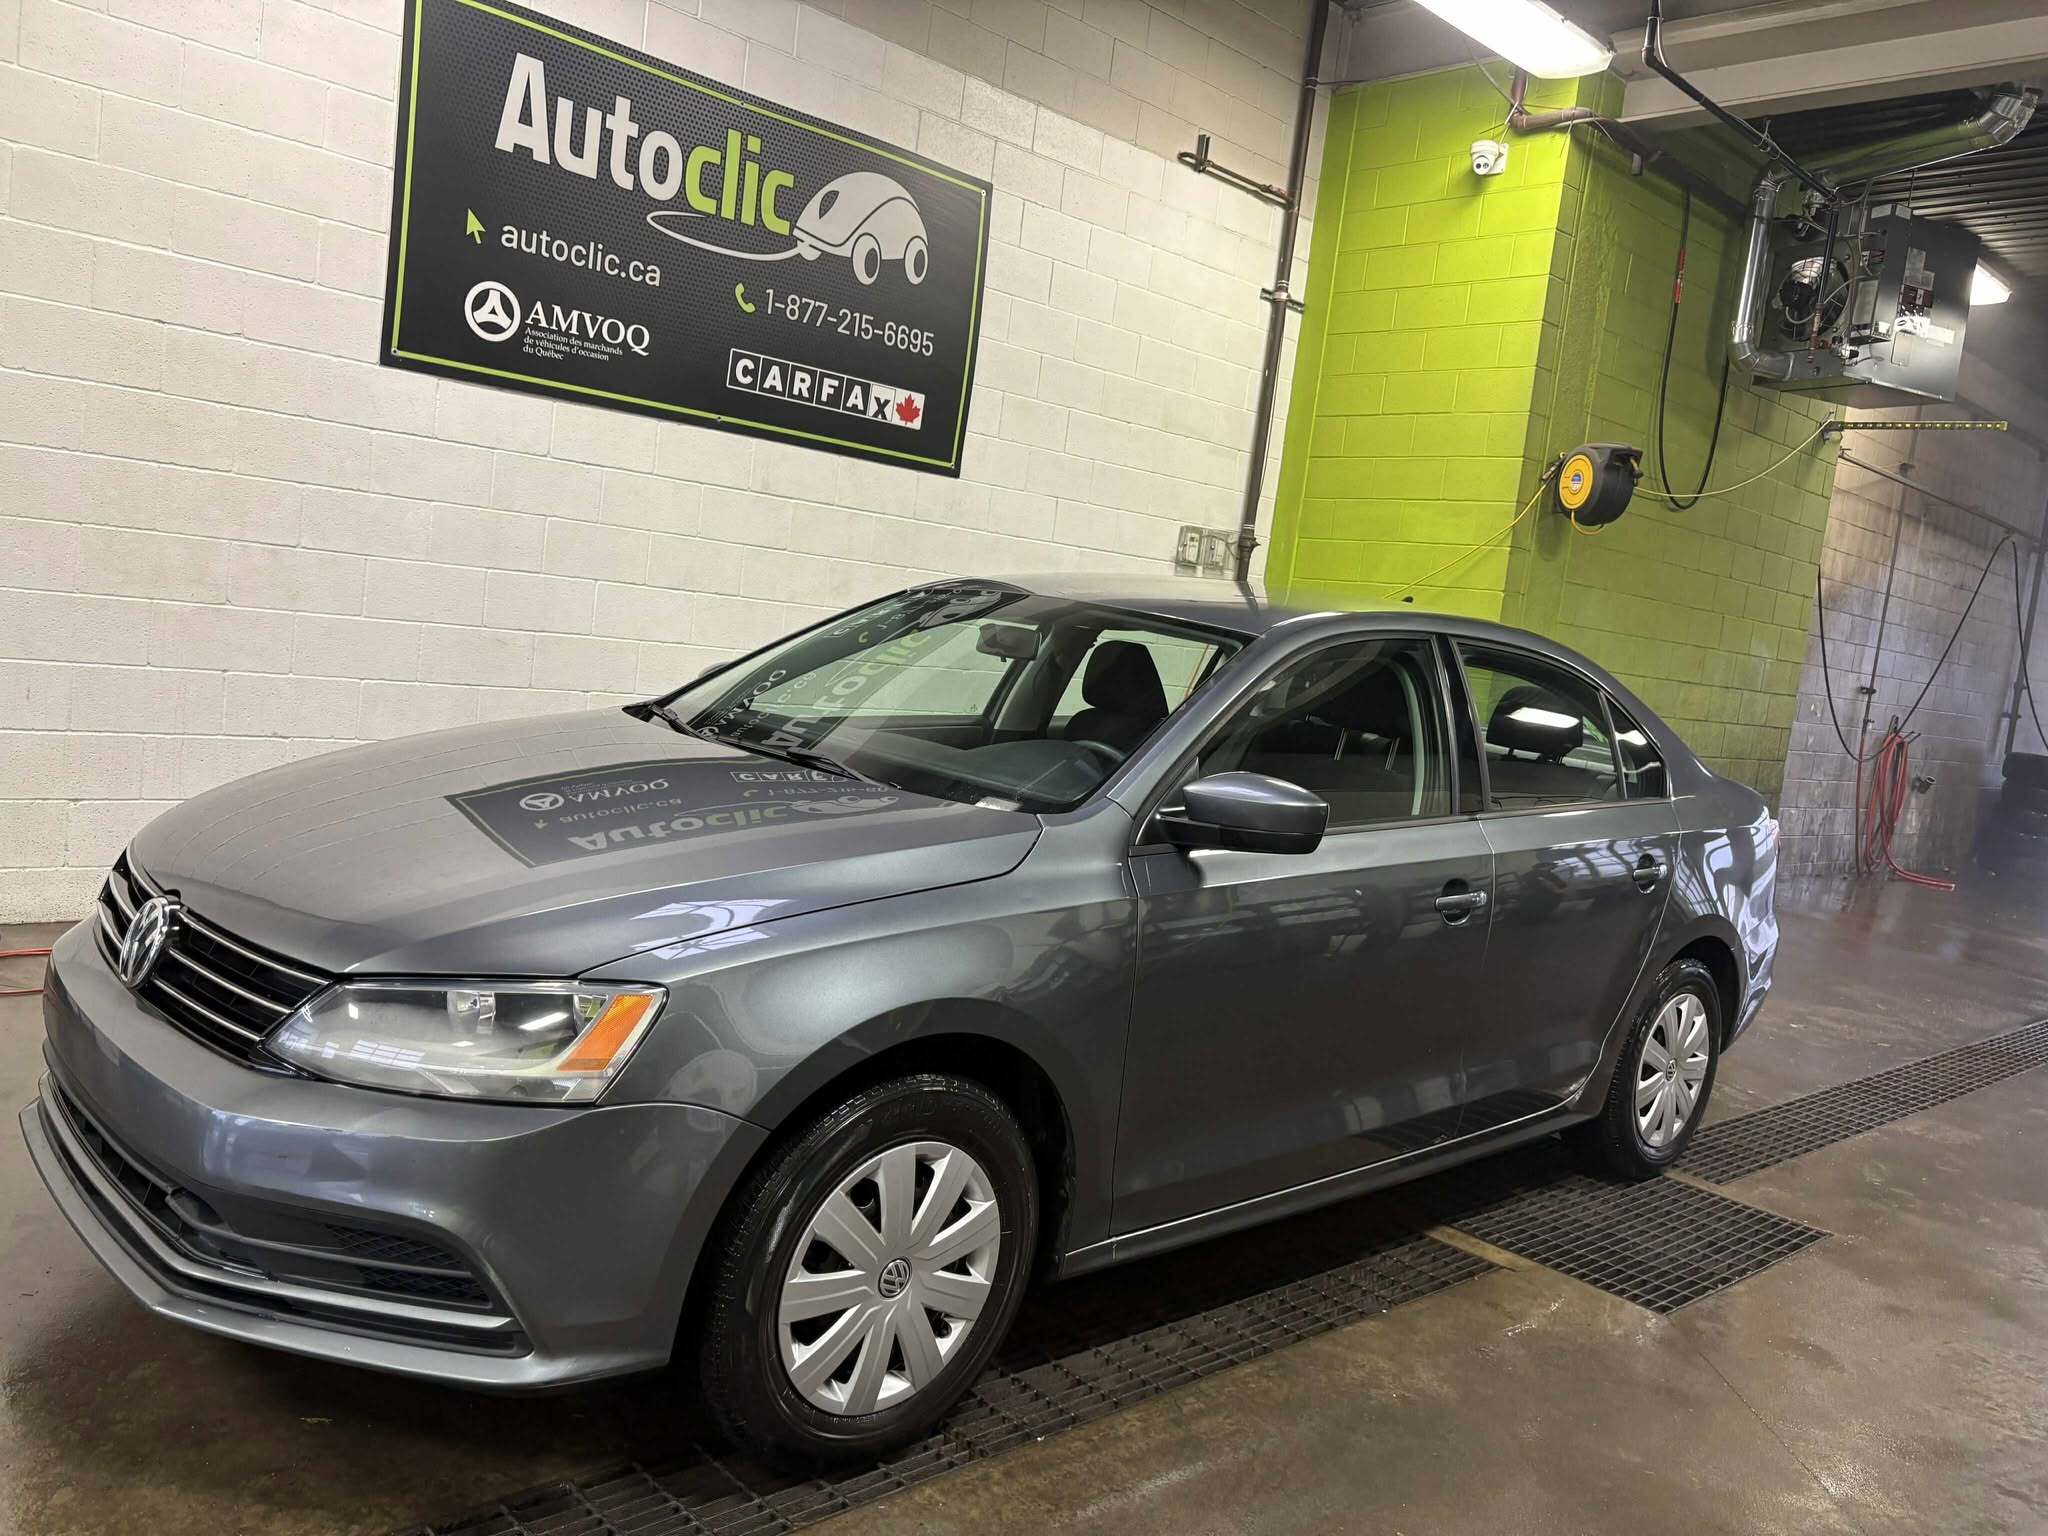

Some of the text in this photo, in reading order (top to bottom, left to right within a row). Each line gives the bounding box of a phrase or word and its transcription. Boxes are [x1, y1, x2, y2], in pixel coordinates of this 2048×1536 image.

[495, 52, 795, 236] Autoclic
[500, 225, 661, 287] autoclic.ca
[523, 335, 534, 345] de
[535, 339, 570, 353] véhicules
[523, 345, 564, 360] du Québec
[525, 300, 650, 356] AMVOQ
[525, 327, 623, 356] Association des marchands
[765, 289, 935, 357] 1-877-215-6695
[735, 358, 892, 421] CARFAX
